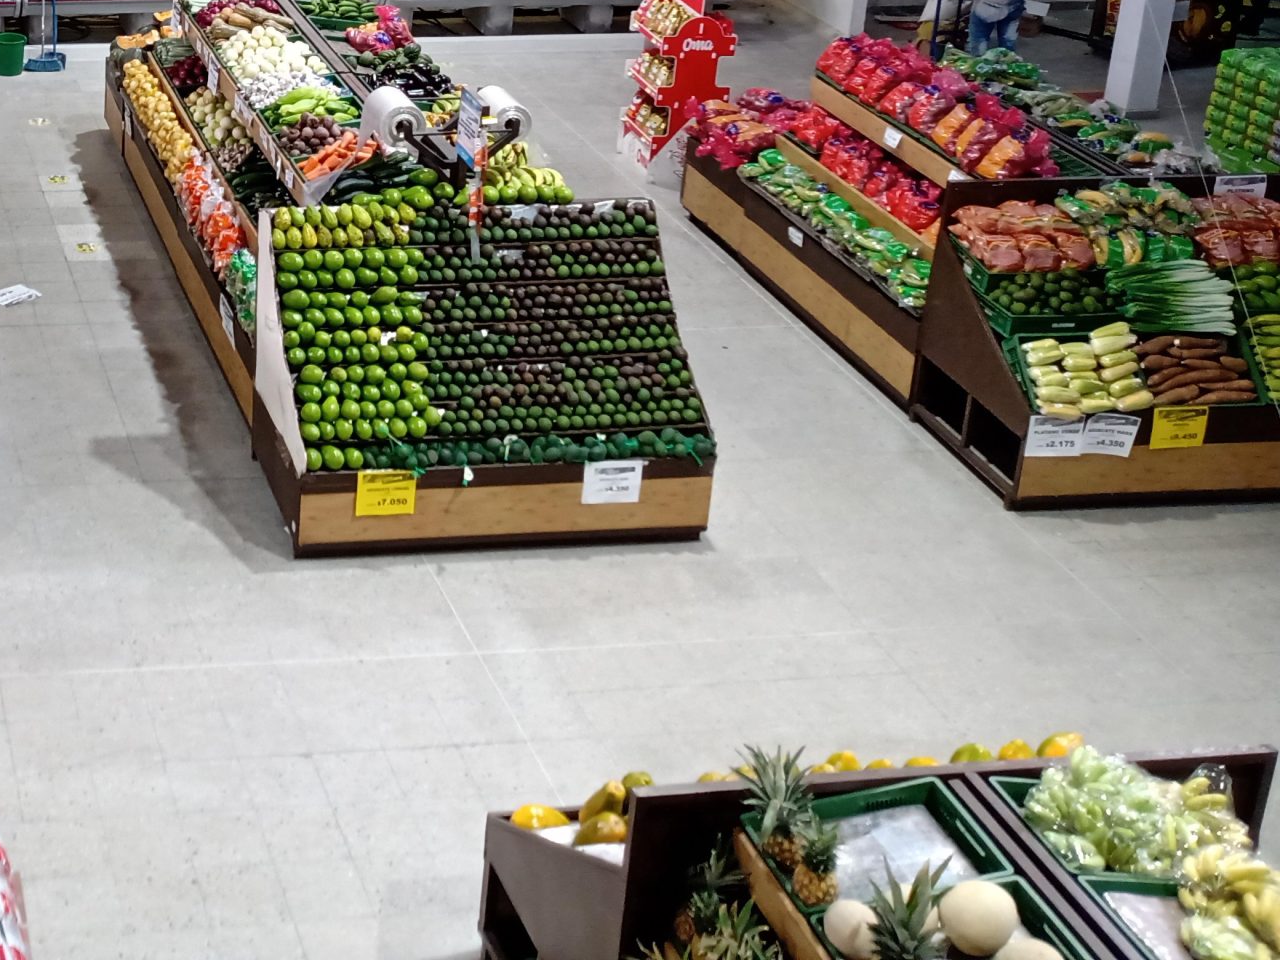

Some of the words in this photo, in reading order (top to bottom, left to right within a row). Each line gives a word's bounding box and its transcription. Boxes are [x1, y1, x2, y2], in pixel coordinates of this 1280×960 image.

[683, 38, 714, 52] Oma
[1046, 440, 1075, 448] $2.175
[1096, 440, 1125, 448] $4.350
[377, 498, 408, 506] $7.050
